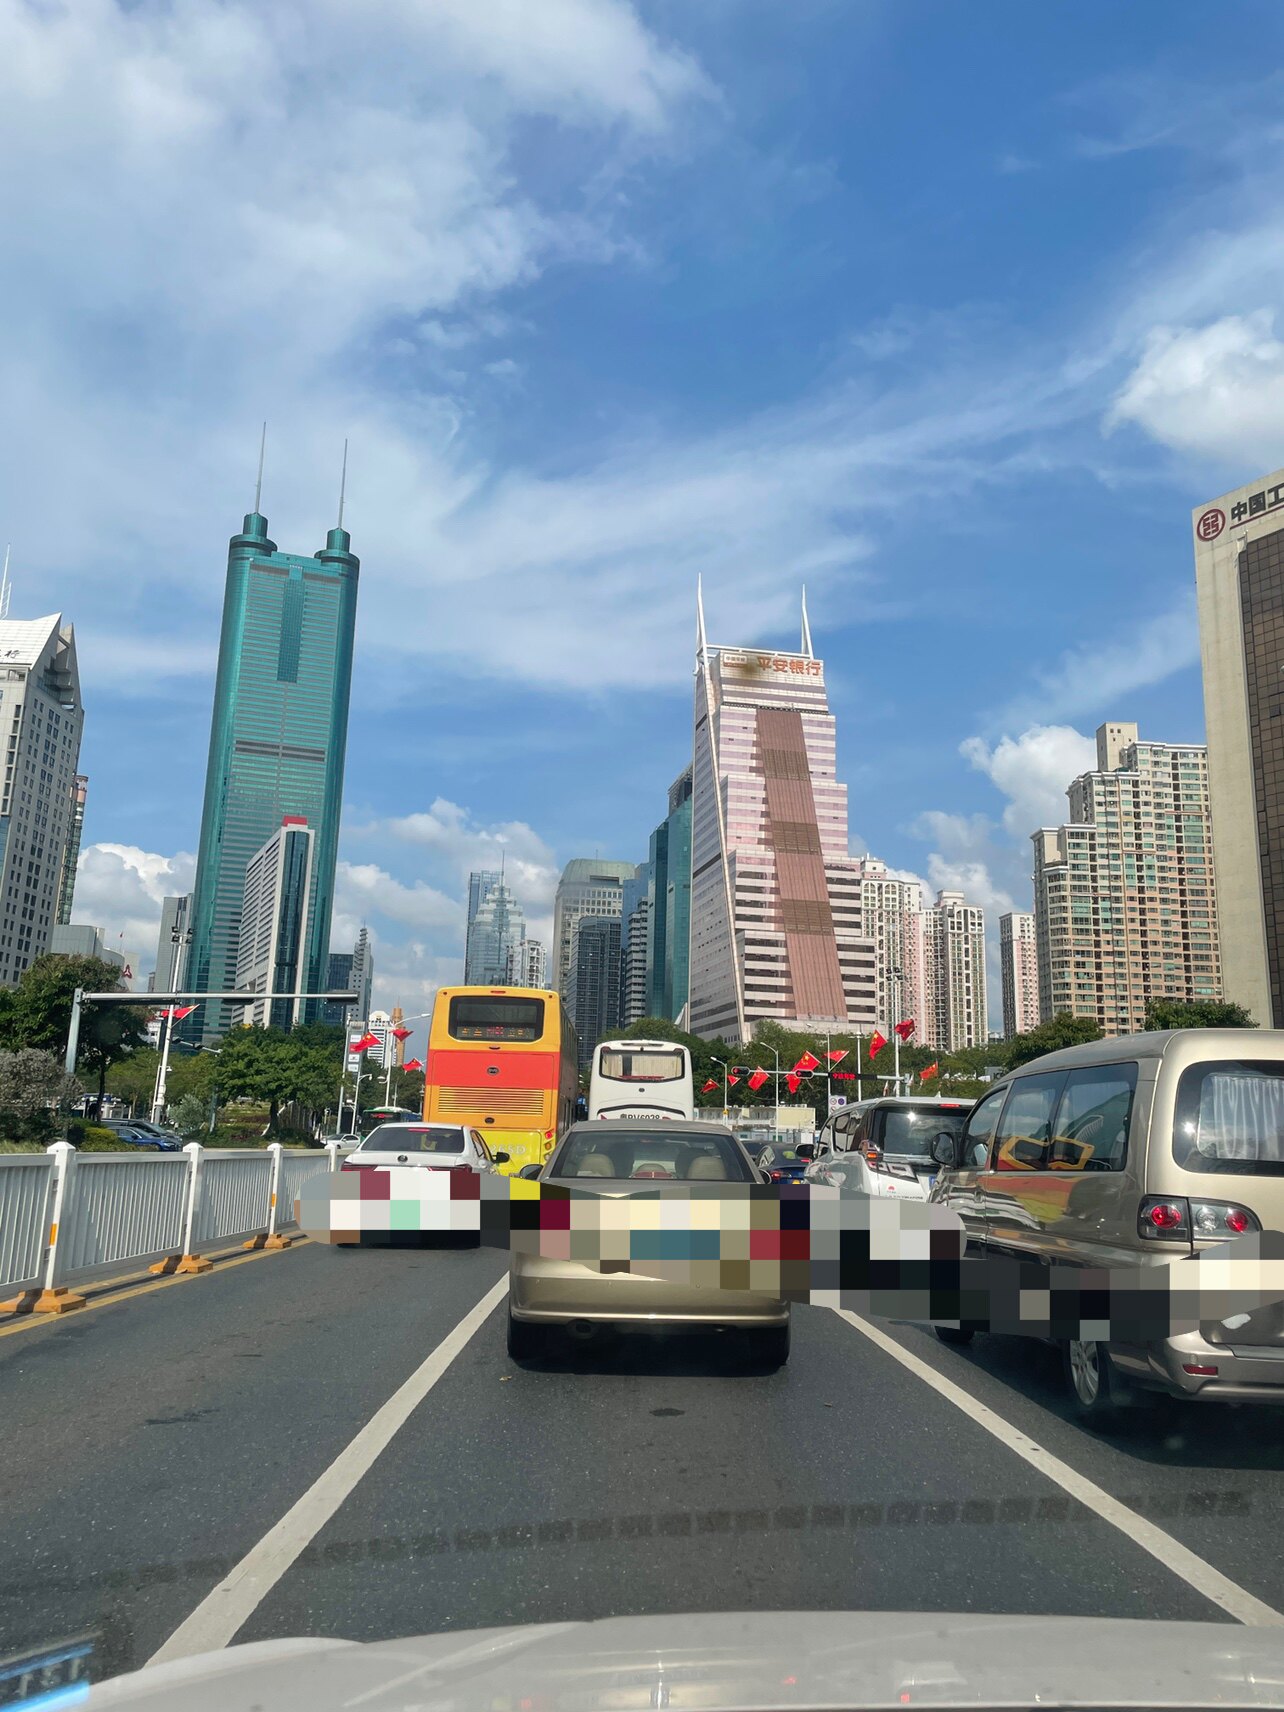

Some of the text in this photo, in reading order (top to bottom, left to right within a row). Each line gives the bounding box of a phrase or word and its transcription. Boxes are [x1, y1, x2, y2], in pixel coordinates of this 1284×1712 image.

[1231, 483, 1284, 522] 中国工
[757, 655, 821, 676] 平安银行
